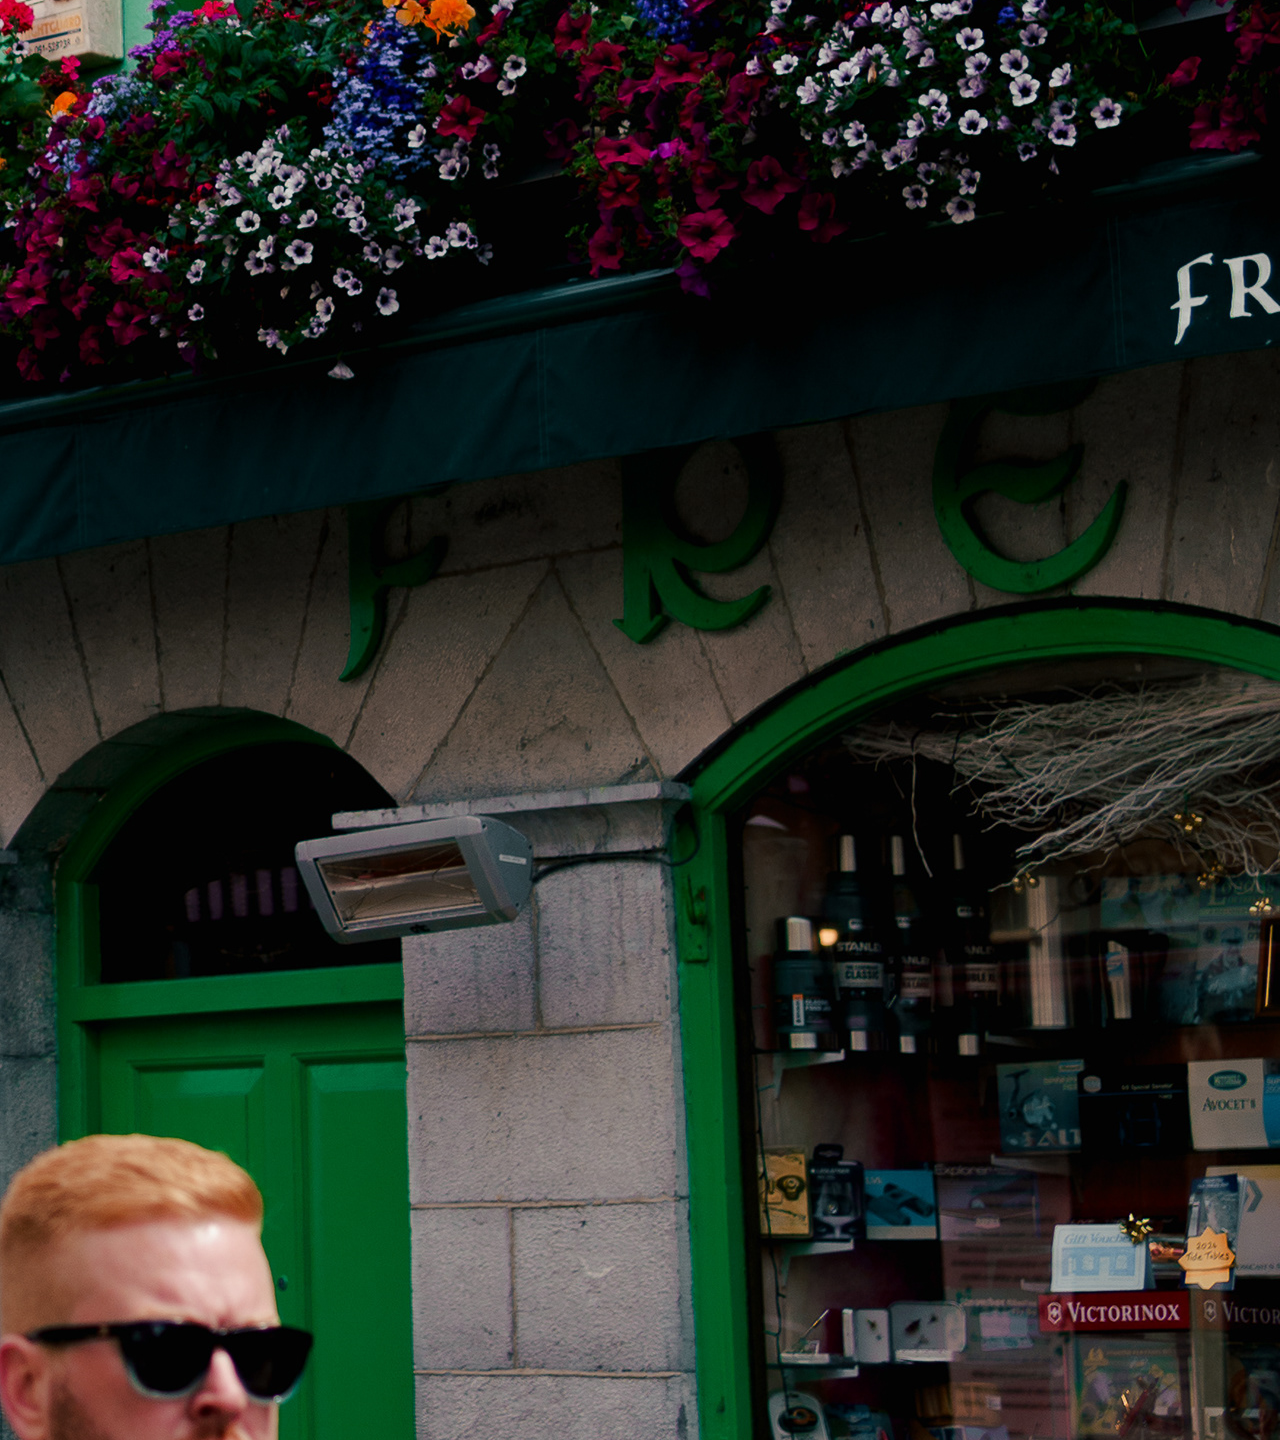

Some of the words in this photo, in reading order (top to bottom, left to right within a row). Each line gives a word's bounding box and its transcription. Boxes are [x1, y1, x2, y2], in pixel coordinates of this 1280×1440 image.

[1064, 1233, 1087, 1244] Gift
[1067, 1301, 1181, 1323] VICTORINOX
[1222, 1300, 1280, 1325] VICTOR
